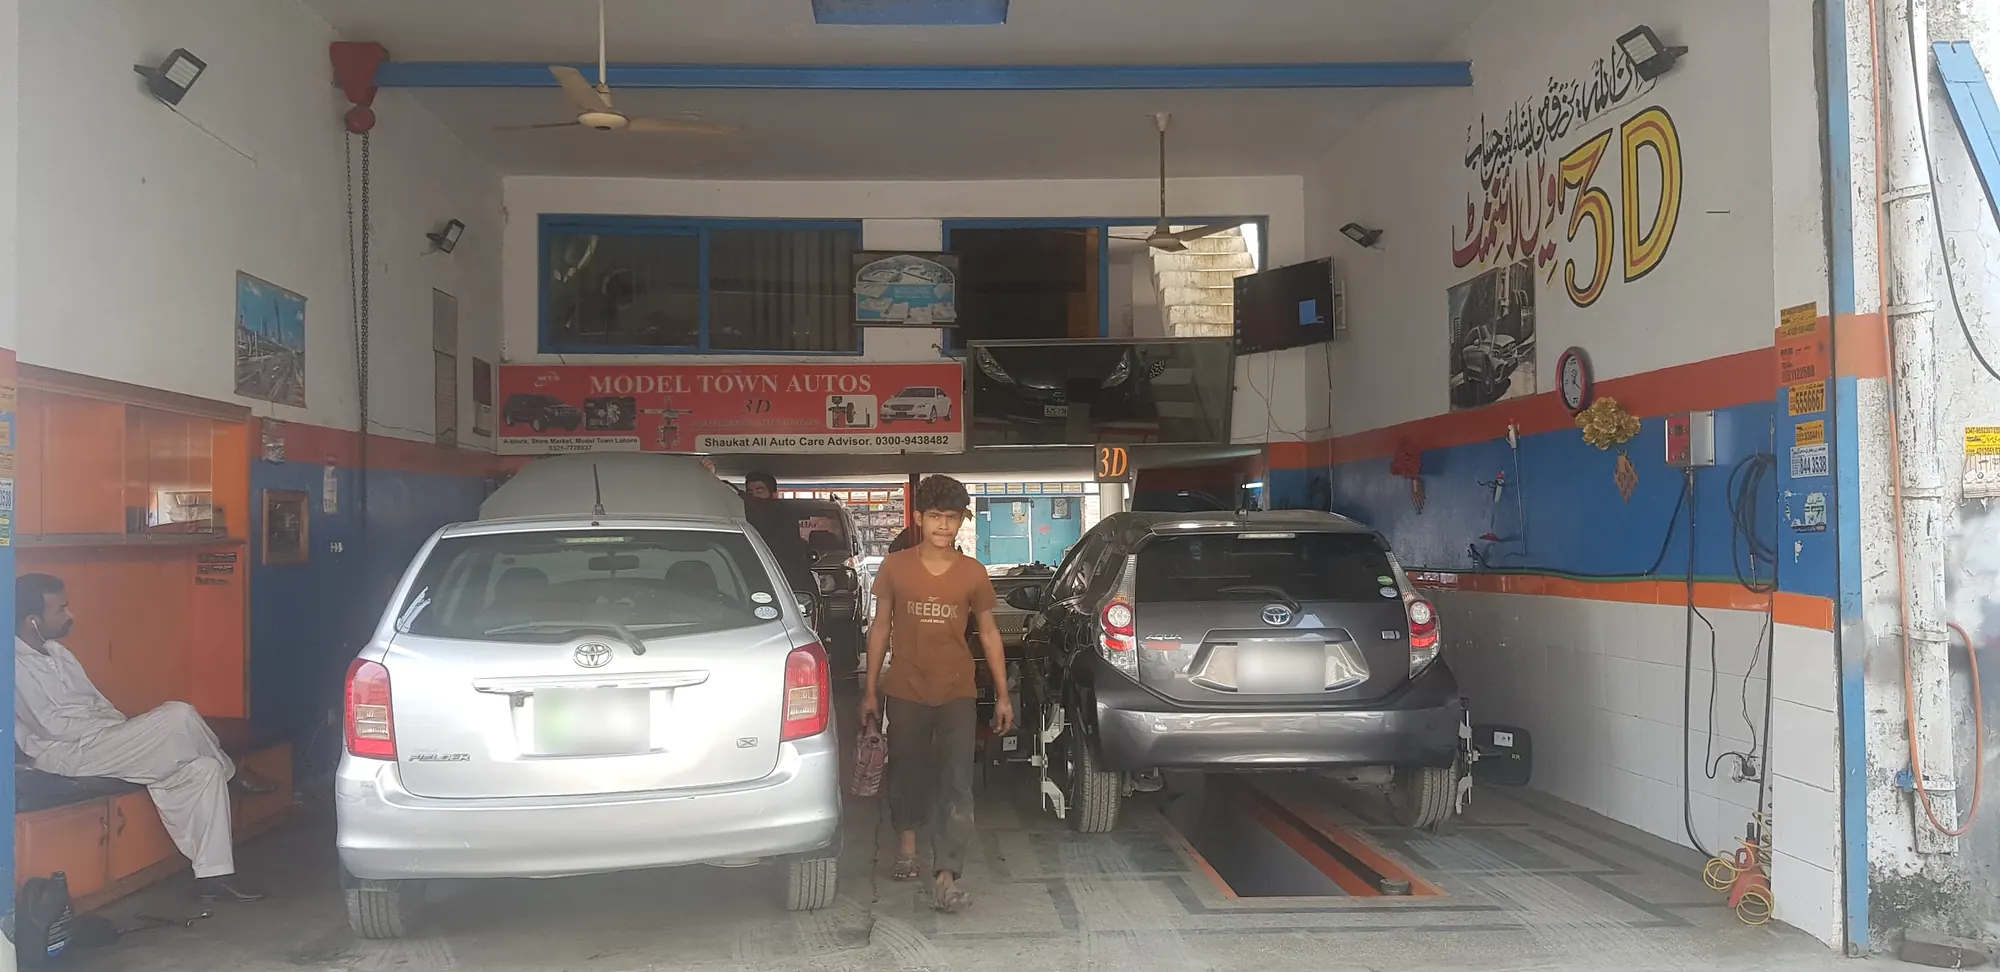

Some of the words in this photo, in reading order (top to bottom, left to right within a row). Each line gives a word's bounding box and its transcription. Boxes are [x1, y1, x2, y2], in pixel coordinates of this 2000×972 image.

[1558, 105, 1684, 308] 3D
[590, 375, 691, 394] MODEL
[697, 374, 779, 393] TOWN
[786, 374, 873, 392] AUTOS
[704, 437, 750, 448] Shaukat
[752, 437, 768, 447] Ali
[771, 437, 797, 447] Auto
[799, 437, 825, 446] Care
[828, 436, 873, 447] Advisor.
[875, 435, 949, 446] 0300-9438482
[1098, 447, 1128, 478] 3D
[907, 601, 958, 619] REEBOK
